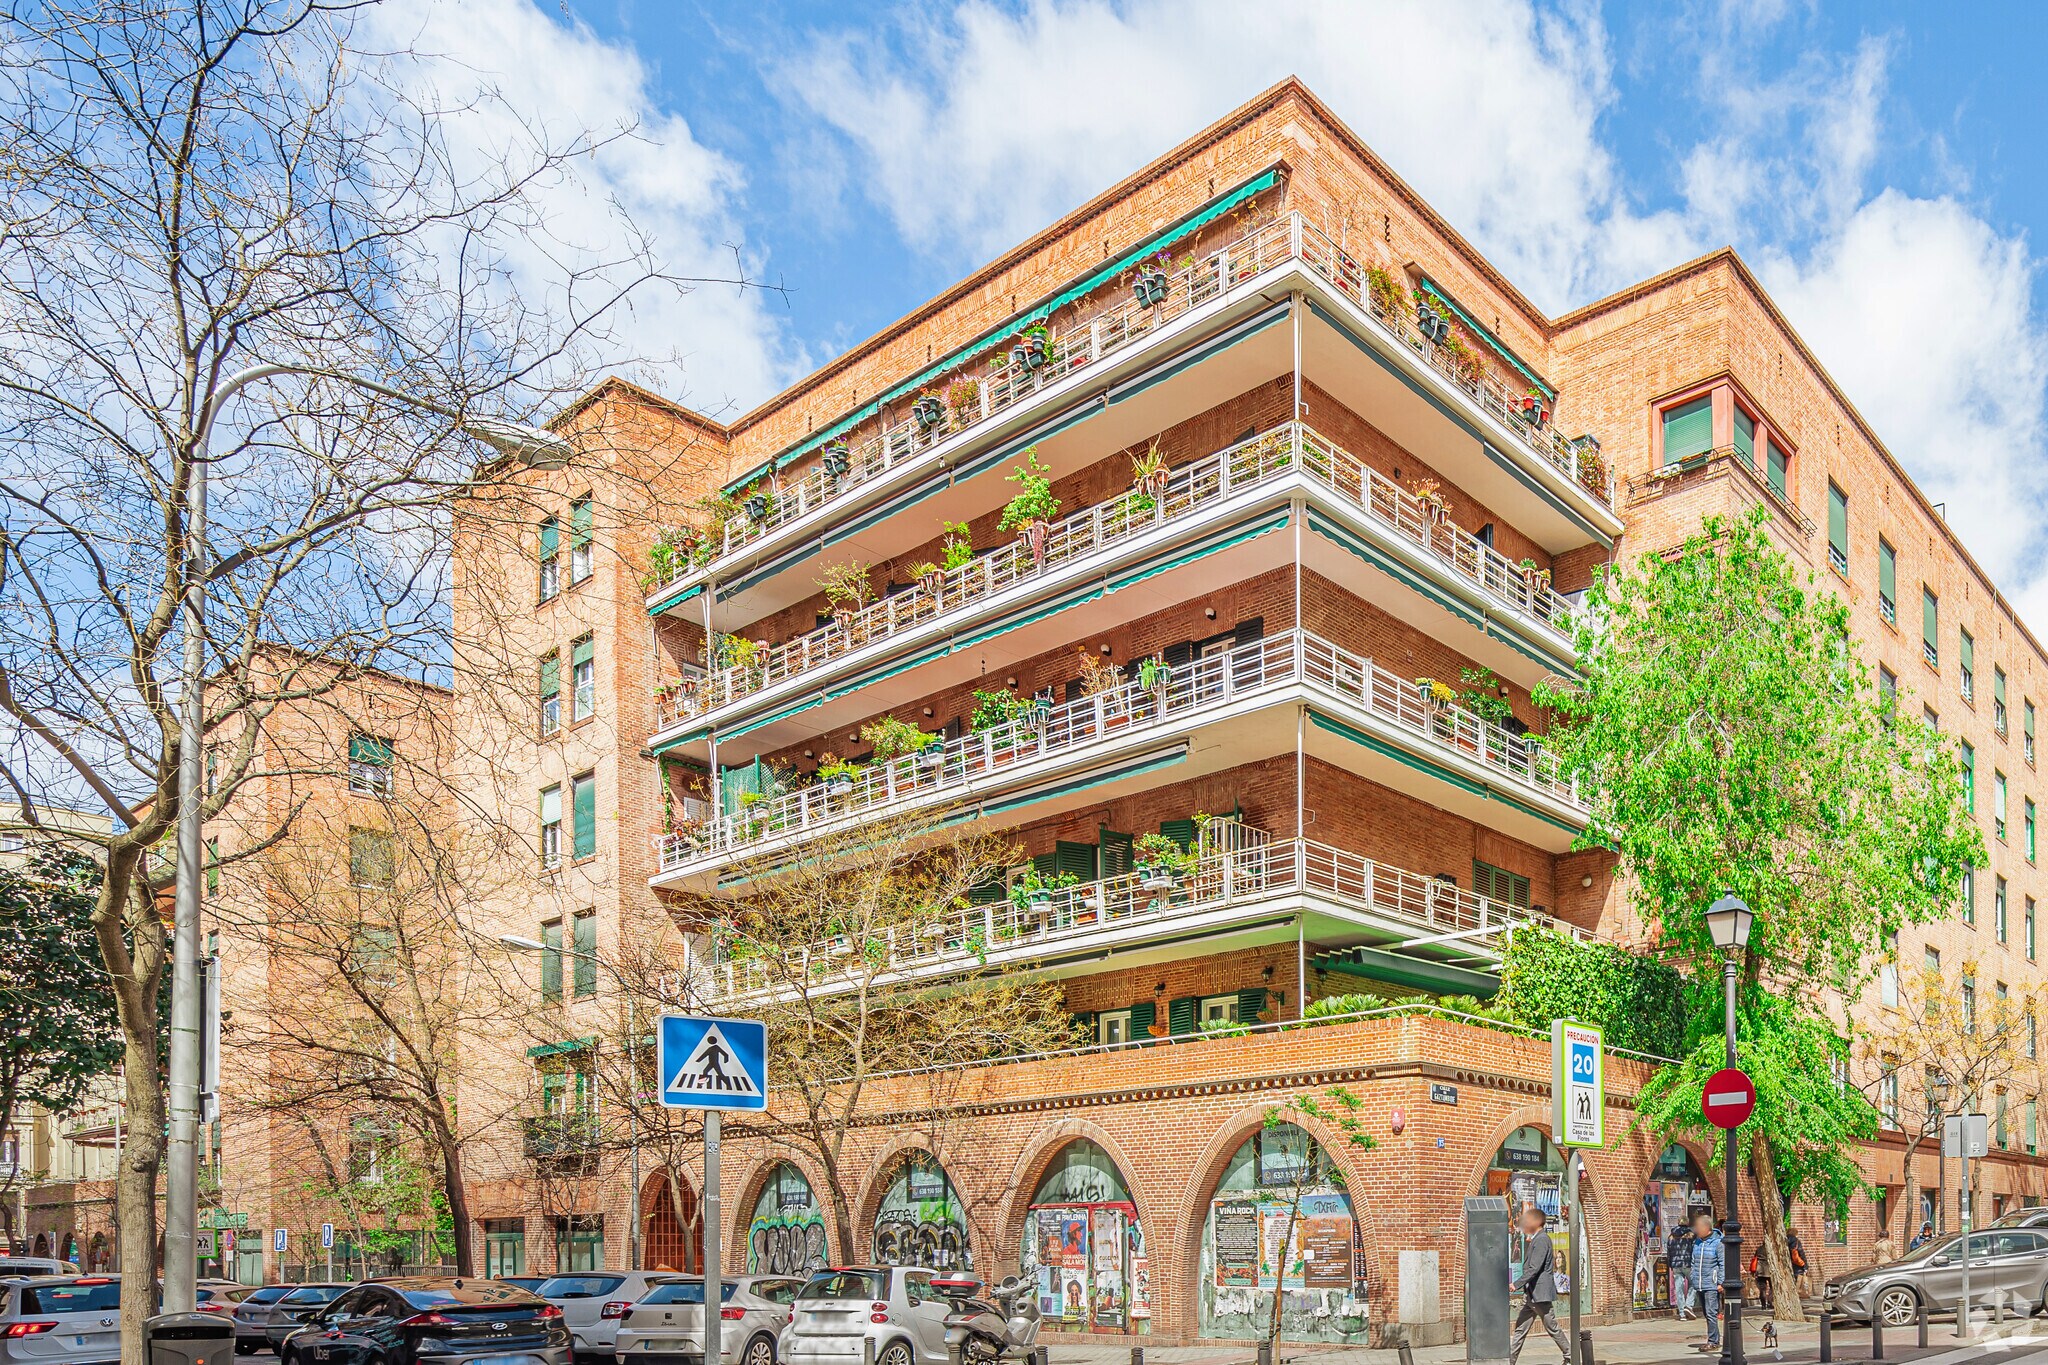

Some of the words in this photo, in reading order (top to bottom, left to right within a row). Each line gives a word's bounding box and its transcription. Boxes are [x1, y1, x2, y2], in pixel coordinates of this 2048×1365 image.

[1567, 1030, 1599, 1045] PRECAUCIÓN
[1573, 1053, 1594, 1076] 20
[1572, 1128, 1583, 1136] Casa
[1577, 1134, 1590, 1142] Flores
[1513, 1152, 1522, 1161] 638
[1218, 1205, 1237, 1215] VIÑA
[1237, 1206, 1255, 1215] ROCK
[313, 1345, 330, 1361] Uber
